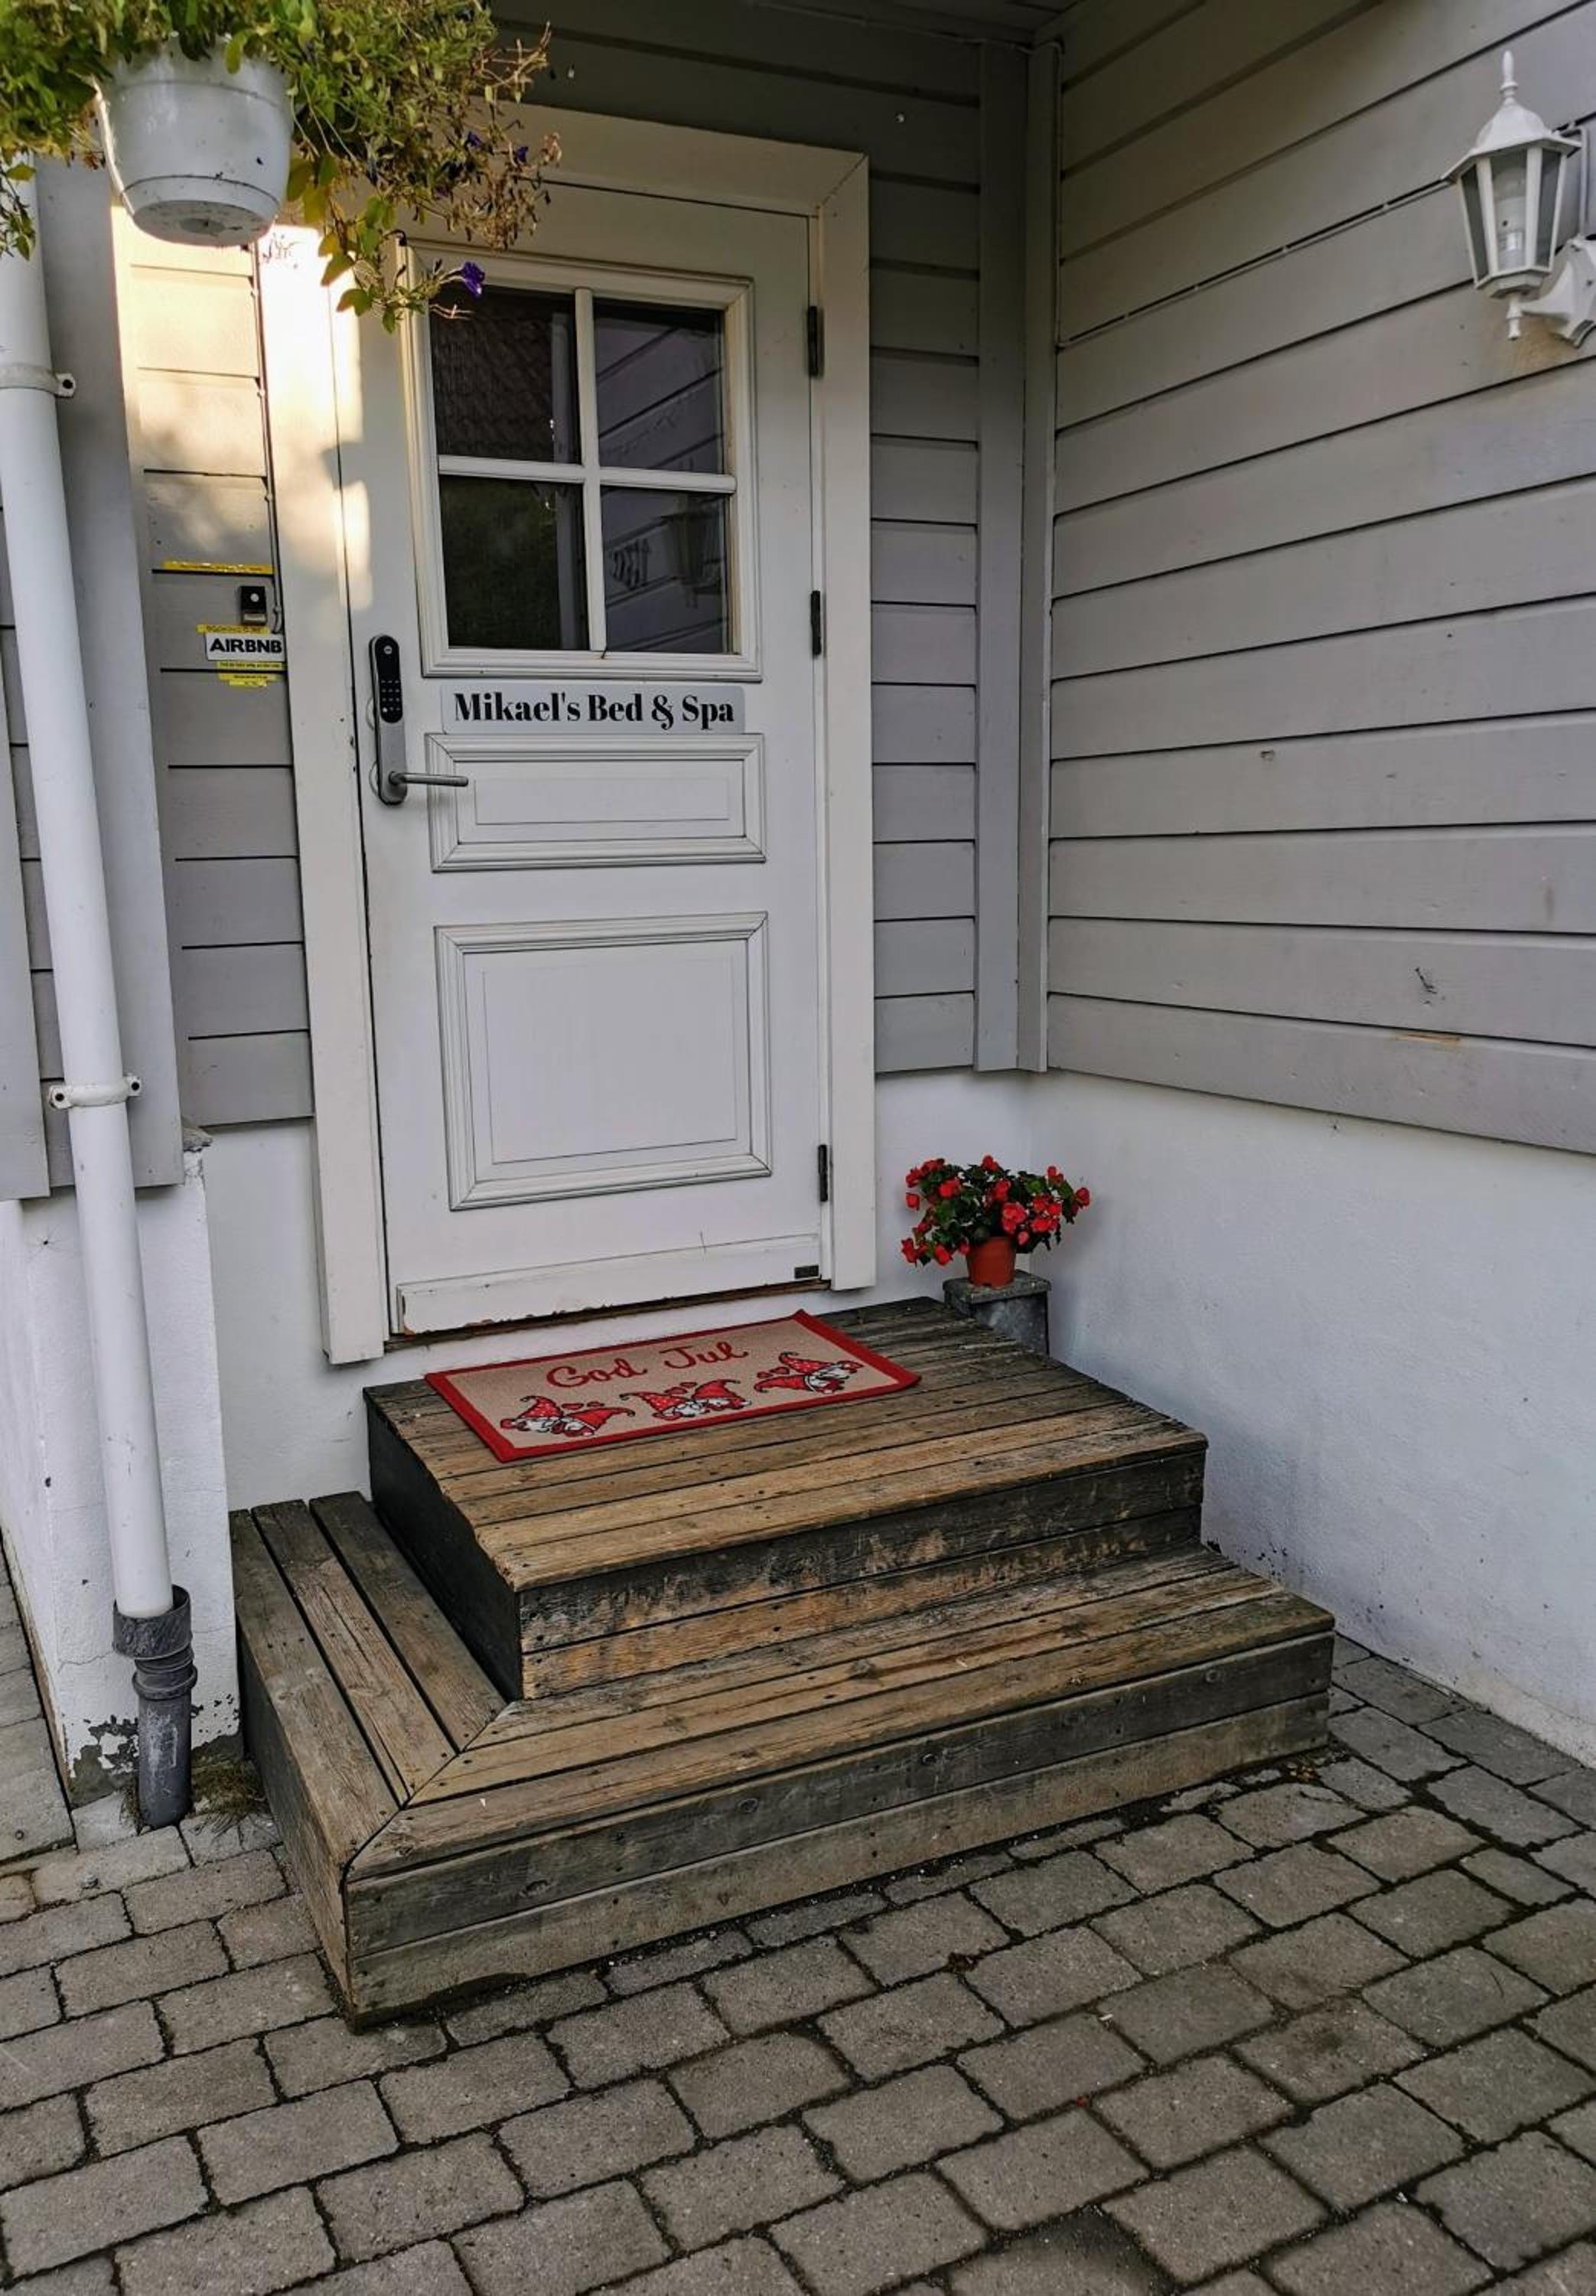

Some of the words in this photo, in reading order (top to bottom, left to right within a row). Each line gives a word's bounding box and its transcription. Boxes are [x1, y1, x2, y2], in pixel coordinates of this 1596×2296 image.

[210, 638, 282, 654] AIRBNB
[453, 692, 581, 722] Mikael's
[587, 693, 643, 722] Bed
[650, 694, 676, 730] &
[682, 695, 735, 730] Spa
[547, 1358, 649, 1388] God
[660, 1341, 750, 1369] Jul
